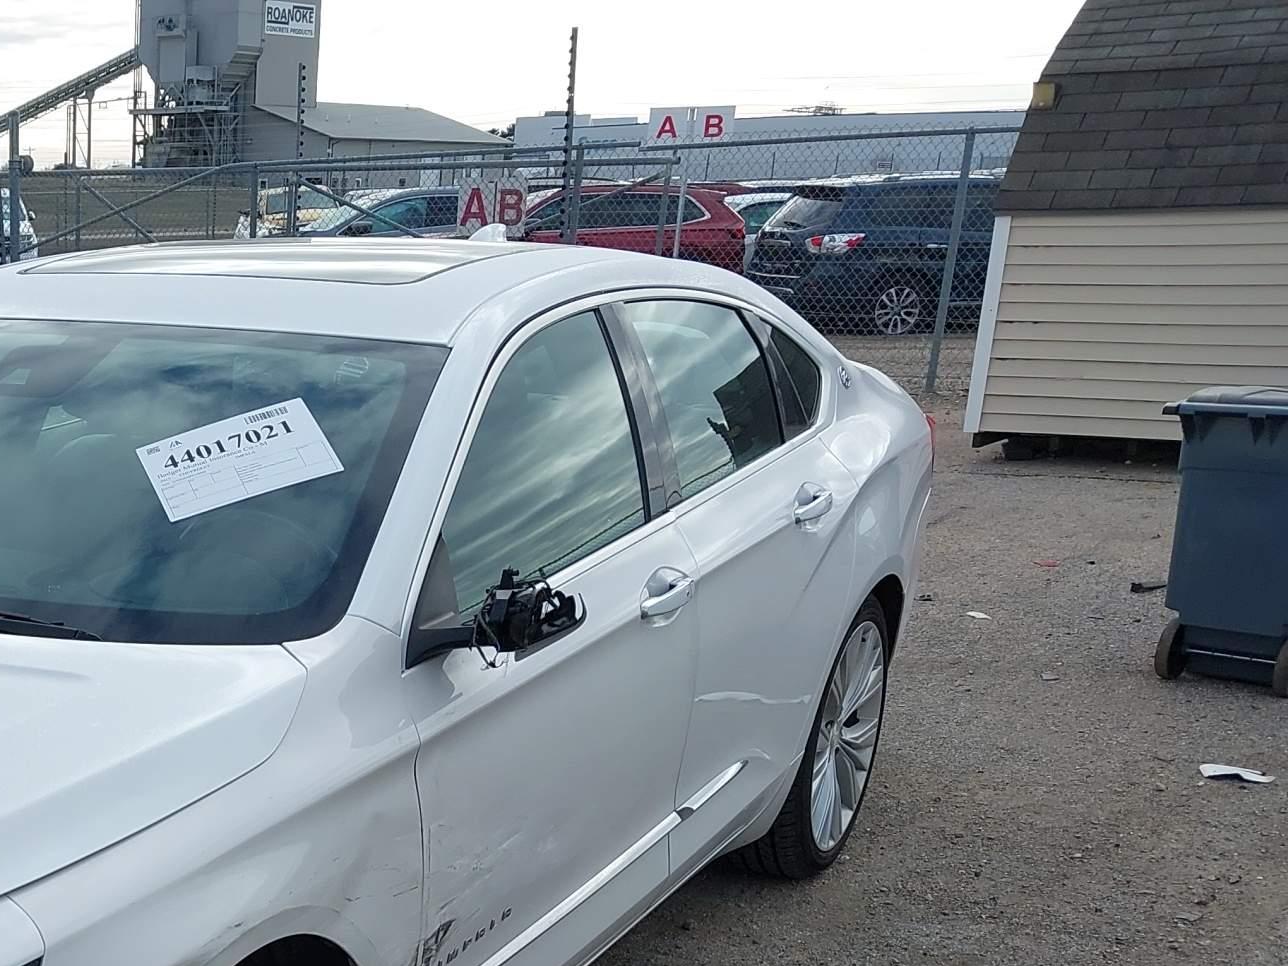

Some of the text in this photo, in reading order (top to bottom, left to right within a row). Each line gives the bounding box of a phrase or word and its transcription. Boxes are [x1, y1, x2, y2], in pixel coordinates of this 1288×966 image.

[267, 5, 313, 25] ROANOKE
[266, 25, 313, 36] CONCRETE PRODUCTS
[656, 114, 724, 139] A B
[460, 187, 523, 226] A B
[164, 420, 295, 469] 44017021
